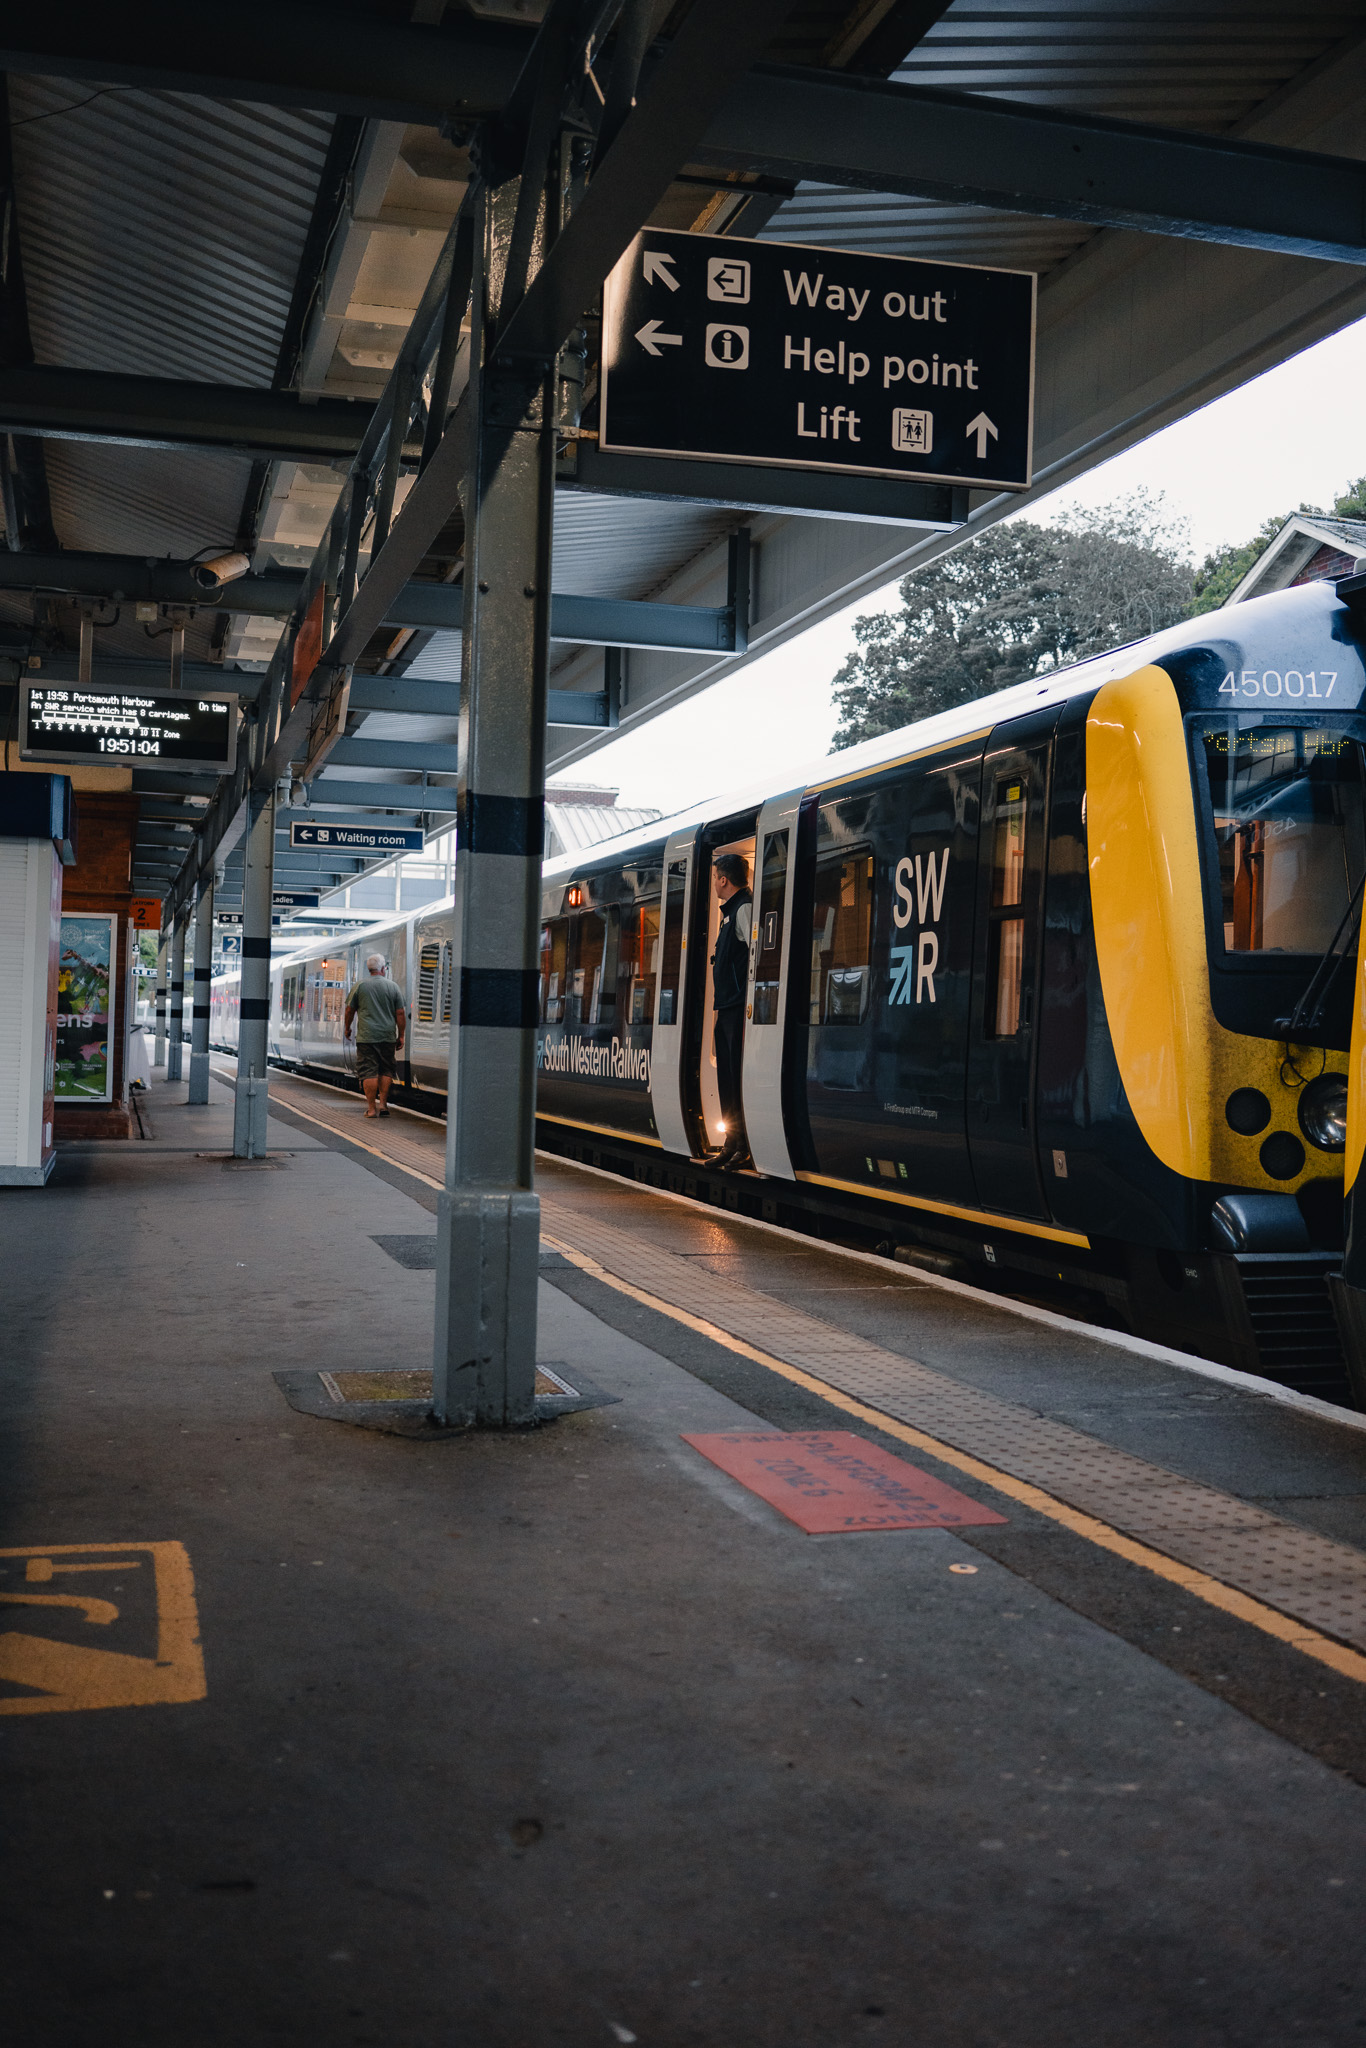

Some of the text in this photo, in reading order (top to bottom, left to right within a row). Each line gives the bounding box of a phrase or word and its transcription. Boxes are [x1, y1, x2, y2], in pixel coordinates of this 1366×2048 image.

[783, 269, 947, 323] Way out
[783, 335, 979, 391] Help point
[797, 401, 861, 442] Lift
[1217, 670, 1338, 699] 450017
[31, 690, 227, 713] 1st 19:56 Portsmouth Harbour On time
[31, 701, 191, 721] An SWR service which has 8 carriages.
[98, 737, 160, 755] 19:51:04
[163, 730, 181, 739] Zone
[1303, 733, 1351, 756] Hbr
[336, 831, 406, 846] Waiting room
[893, 847, 950, 930] SW
[138, 908, 146, 920] 2
[768, 917, 774, 943] 1
[226, 937, 238, 952] 2
[916, 931, 939, 1004] R
[544, 1033, 652, 1094] South Western Railway
[755, 1458, 830, 1488] ZONE
